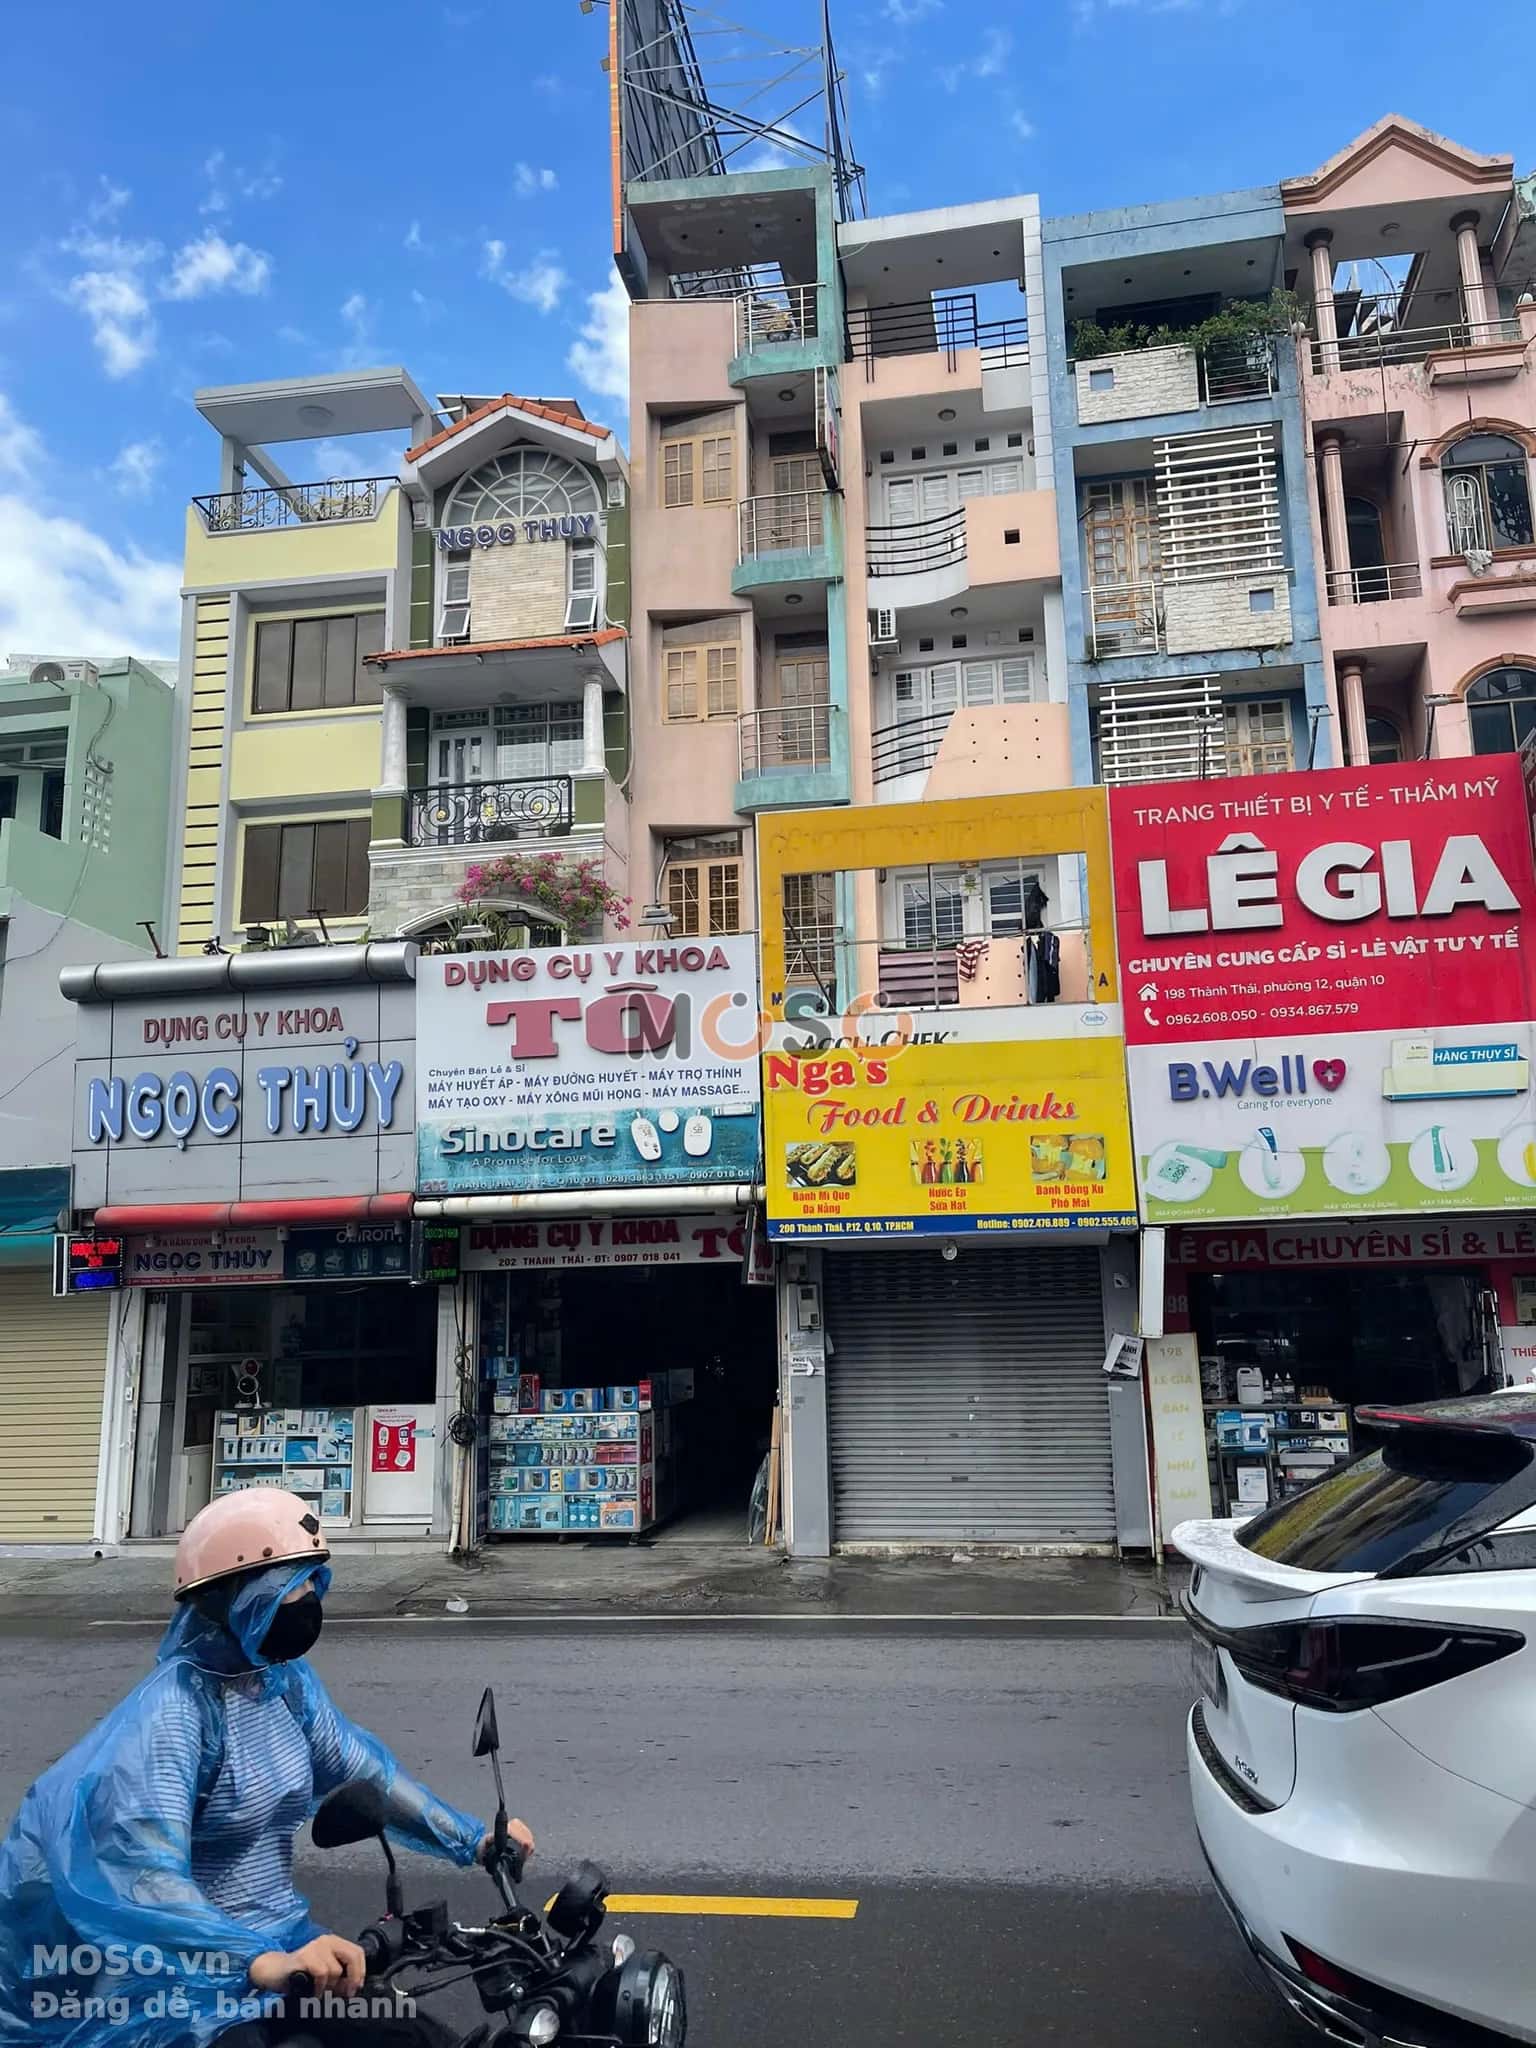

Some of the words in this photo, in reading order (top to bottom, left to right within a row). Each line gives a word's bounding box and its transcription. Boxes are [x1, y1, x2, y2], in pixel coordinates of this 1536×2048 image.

[437, 524, 515, 550] NGỌC
[1133, 804, 1215, 826] TRANG
[1220, 792, 1284, 819] THIẾT
[1290, 796, 1312, 816] BỊ
[1318, 793, 1334, 810] Y
[1340, 784, 1370, 808] TẾ
[1389, 778, 1457, 804] THẨM
[1464, 776, 1500, 798] MỸ
[1138, 831, 1284, 936] LÊ
[1296, 834, 1521, 922] GIA
[1128, 952, 1212, 974] CHUYÊN
[1216, 949, 1274, 967] CUNG
[1278, 940, 1321, 963] CẤP
[1390, 936, 1429, 960] VẬT
[1434, 936, 1466, 953] TƯ
[1469, 936, 1485, 949] Y
[1489, 925, 1520, 949] TẾ
[443, 957, 537, 992] DỤNG
[547, 953, 592, 984] CỤ
[604, 951, 628, 977] Y
[635, 946, 730, 974] KHOA
[1098, 973, 1109, 987] A
[1164, 988, 1186, 999] 198
[1190, 985, 1228, 998] Thành
[1231, 983, 1259, 996] Thái,
[1263, 981, 1312, 994] phường
[1315, 978, 1332, 991] 12,
[1336, 977, 1367, 990] quận
[1371, 974, 1385, 986] 10
[1166, 1007, 1257, 1026] 0962.608.050
[1269, 1001, 1359, 1019] 0934.867.579
[143, 1016, 209, 1048] DỤNG
[215, 1012, 247, 1044] CỤ
[254, 1012, 270, 1036] Y
[277, 1006, 344, 1035] KHOA
[1434, 1049, 1468, 1062] HÀNG
[1469, 1048, 1502, 1062] THỤY
[428, 1081, 453, 1093] MÁY
[457, 1076, 495, 1091] HUYẾT
[498, 1078, 513, 1088] ÁP
[525, 1075, 549, 1087] MÁY
[553, 1072, 595, 1086] ĐƯỜNG
[599, 1069, 638, 1083] HUYẾT
[649, 1068, 674, 1081] MÁY
[678, 1069, 702, 1082] TRỢ
[705, 1066, 742, 1079] THÍNH
[429, 1067, 465, 1078] Chuyên
[468, 1066, 487, 1075] Bán
[766, 1053, 888, 1095] Nga's
[1168, 1054, 1307, 1101] B.Well
[88, 1067, 240, 1151] NGỌC
[257, 1036, 402, 1134] THỦY
[428, 1097, 453, 1109] MÁY
[457, 1097, 480, 1109] TẠO
[483, 1095, 506, 1106] OXY
[517, 1091, 542, 1104] MÁY
[546, 1090, 579, 1103] XÔNG
[583, 1087, 604, 1101] MŨI
[607, 1089, 641, 1102] HỌNG
[652, 1084, 677, 1098] MÁY
[681, 1083, 750, 1097] MASSAGE...
[1237, 1098, 1268, 1112] Caring
[1270, 1097, 1284, 1109] for
[1286, 1096, 1333, 1109] everyone
[808, 1097, 906, 1134] Food
[916, 1100, 939, 1123] &
[952, 1091, 1079, 1123] Drinks
[440, 1122, 616, 1156] Sinocare
[472, 1158, 480, 1167] A
[484, 1157, 534, 1166] Promise
[536, 1155, 553, 1164] for
[558, 1154, 587, 1164] Love
[690, 1170, 713, 1179] 0907
[1072, 1197, 1090, 1208] Mai
[336, 1226, 395, 1244] ORON
[470, 1224, 538, 1253] DỤNG
[547, 1223, 581, 1251] CỤ
[587, 1222, 604, 1246] Y
[612, 1219, 680, 1245] KHOA
[779, 1223, 795, 1234] 200
[977, 1219, 1011, 1230] Hotline:
[1166, 1235, 1199, 1265] LÊ
[1206, 1239, 1265, 1264] GIA
[1272, 1229, 1411, 1262] CHUYÊN
[1422, 1225, 1450, 1256] SỈ
[1462, 1232, 1487, 1255] &
[1497, 1222, 1536, 1254] LẺ
[135, 1251, 201, 1277] NGỌC
[208, 1244, 273, 1270] THỦY
[498, 1258, 517, 1267] 202
[561, 1253, 584, 1265] THÁI
[614, 1254, 638, 1263] 0907
[642, 1253, 660, 1262] 018
[663, 1252, 680, 1262] 041
